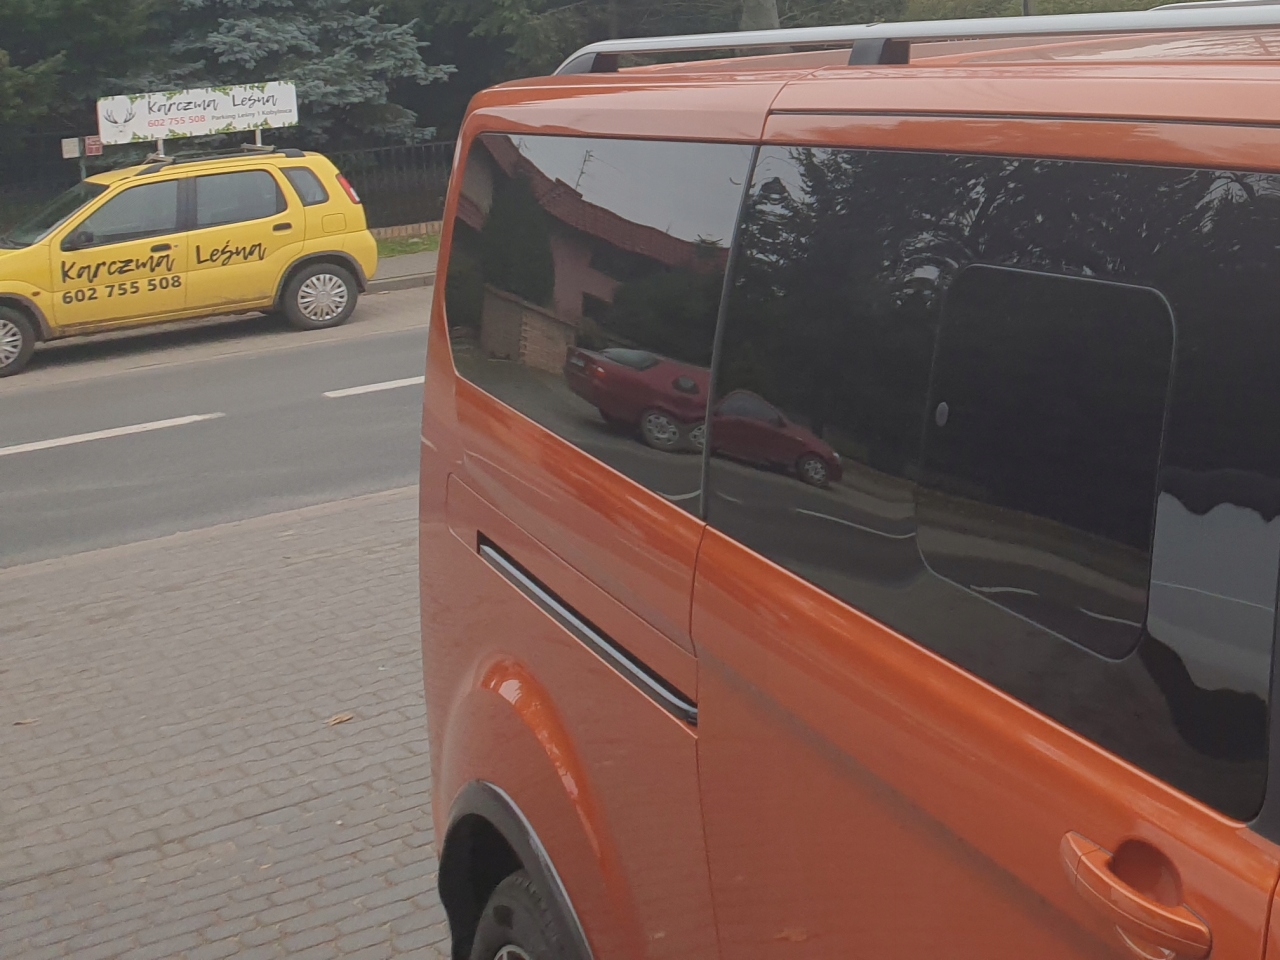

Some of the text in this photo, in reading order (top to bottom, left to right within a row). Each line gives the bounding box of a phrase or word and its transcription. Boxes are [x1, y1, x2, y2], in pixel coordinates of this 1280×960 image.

[148, 93, 278, 115] Karczma Leśna
[148, 115, 205, 127] 602 755 508
[61, 240, 267, 283] Karczma Leśna
[62, 275, 182, 304] 602 755 508
